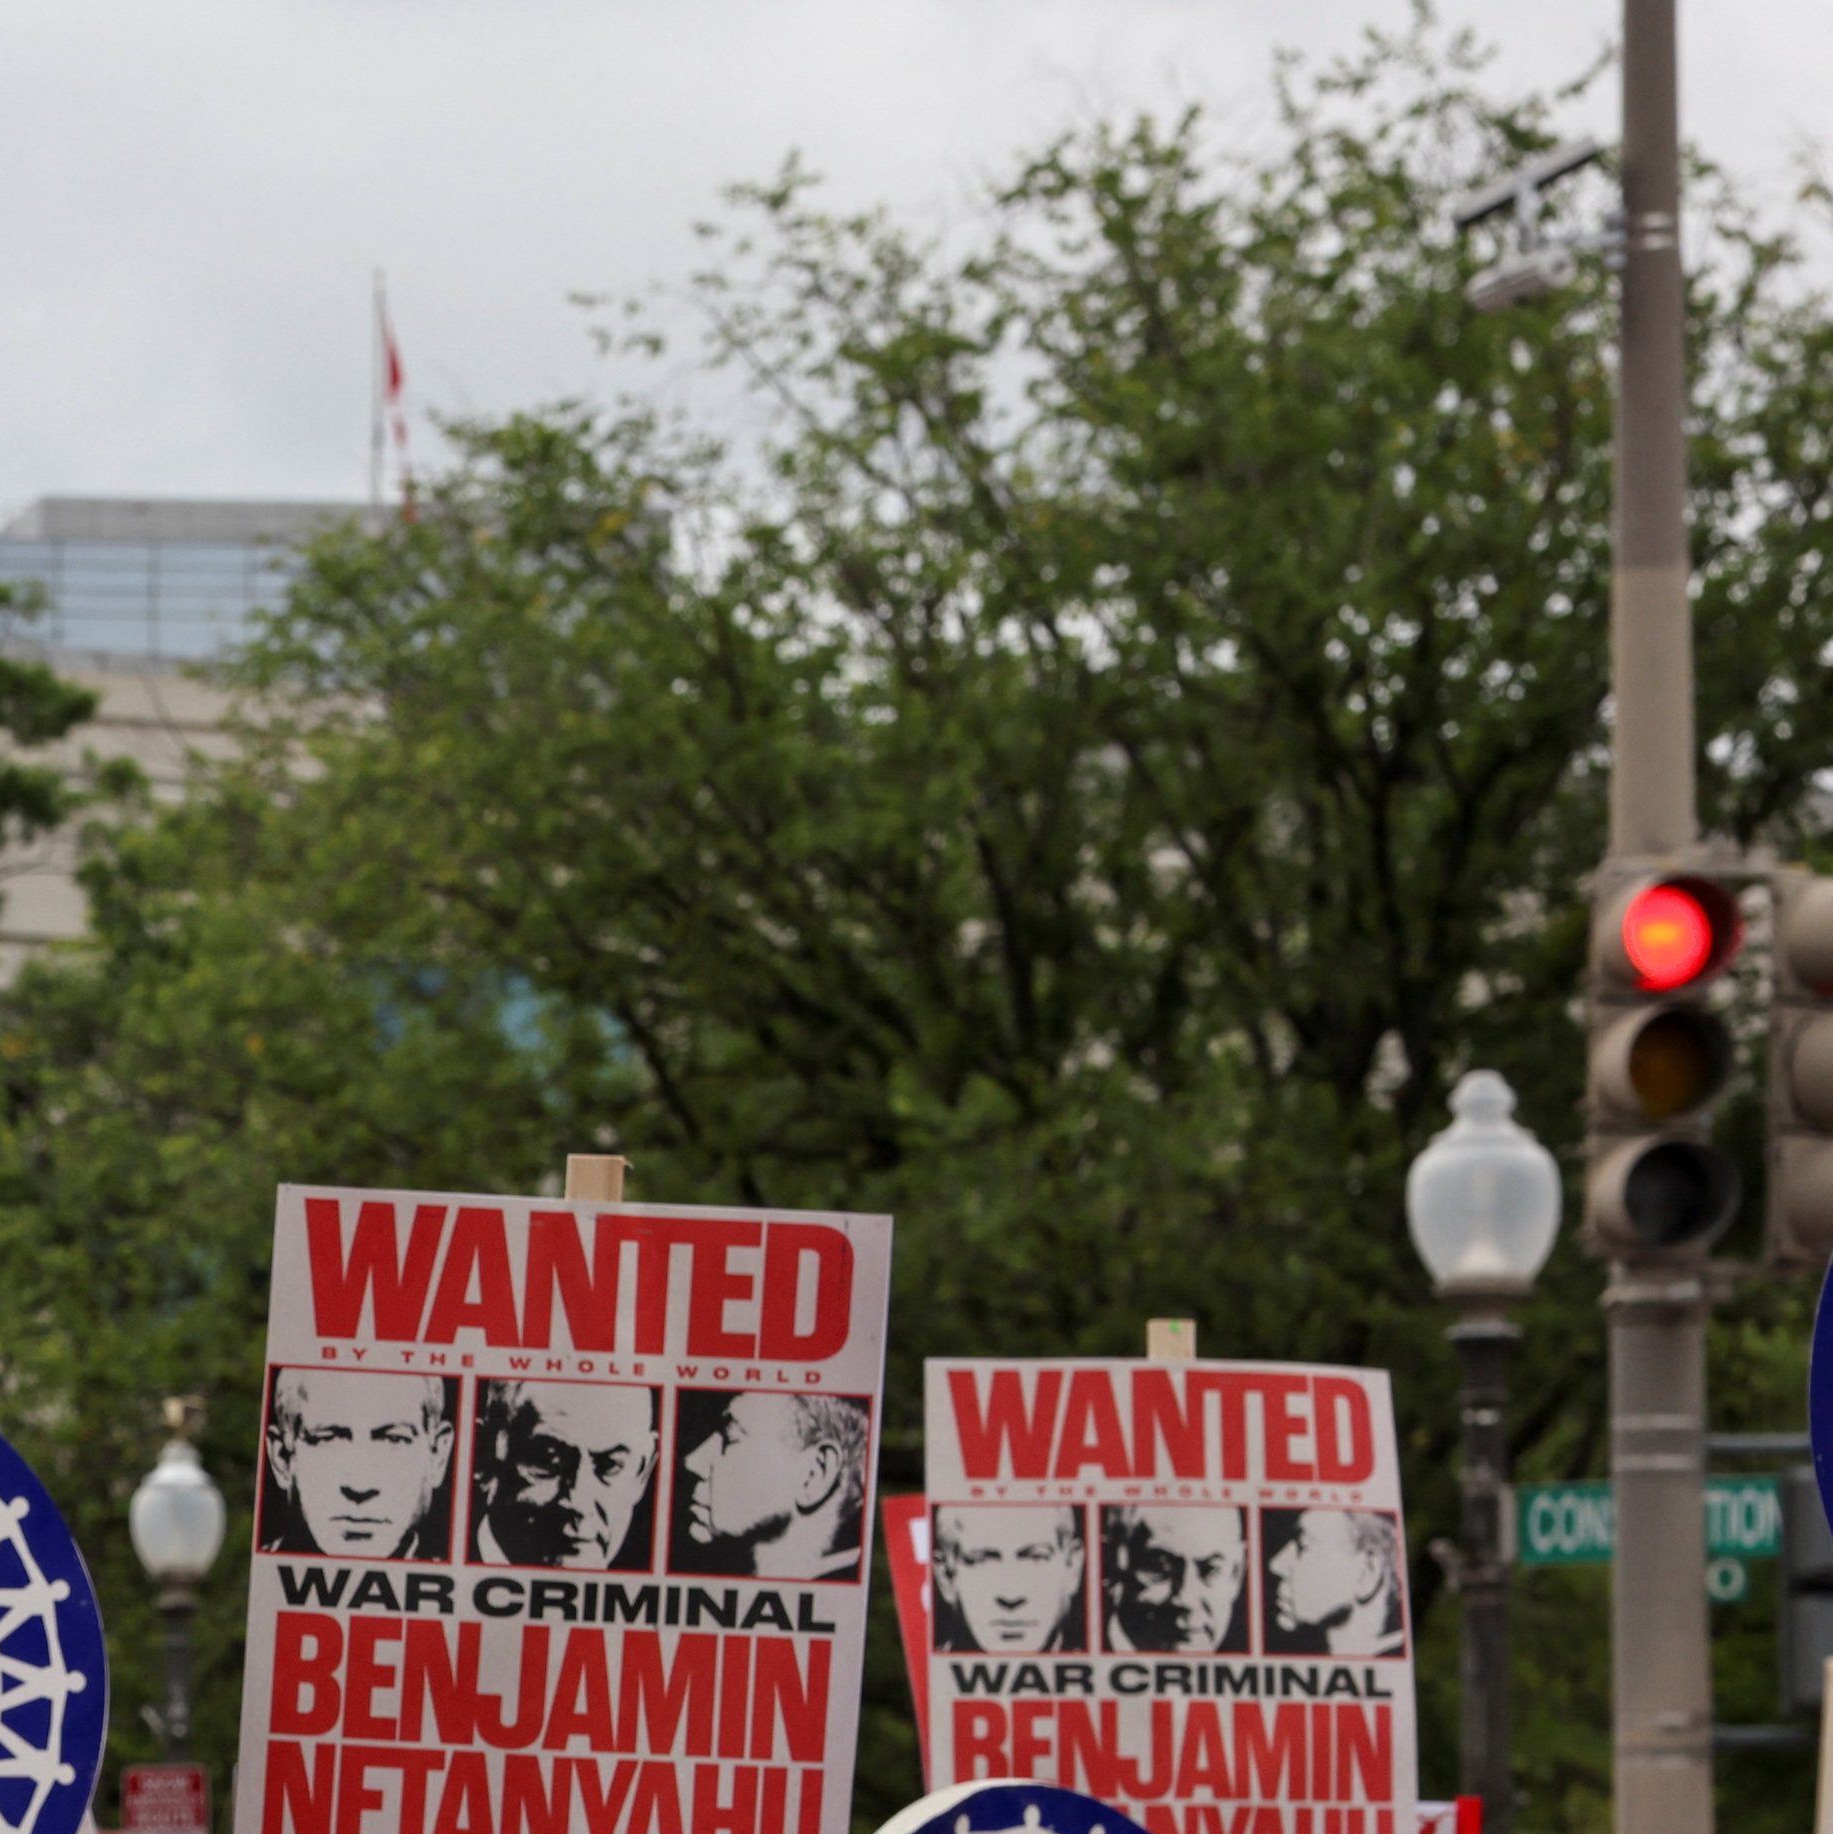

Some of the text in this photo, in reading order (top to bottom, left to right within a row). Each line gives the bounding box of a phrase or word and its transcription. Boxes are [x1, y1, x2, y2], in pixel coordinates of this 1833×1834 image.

[304, 1198, 854, 1362] WANTED
[322, 1346, 823, 1385] BY THE WHOLE WORLD
[947, 1367, 1375, 1484] WANTED
[278, 1565, 835, 1634] WAR CRIMINAL
[270, 1611, 831, 1763] BENJAMIN
[950, 1663, 1392, 1697] WAR CRIMINAL
[952, 1699, 1392, 1802] BENJAMIN
